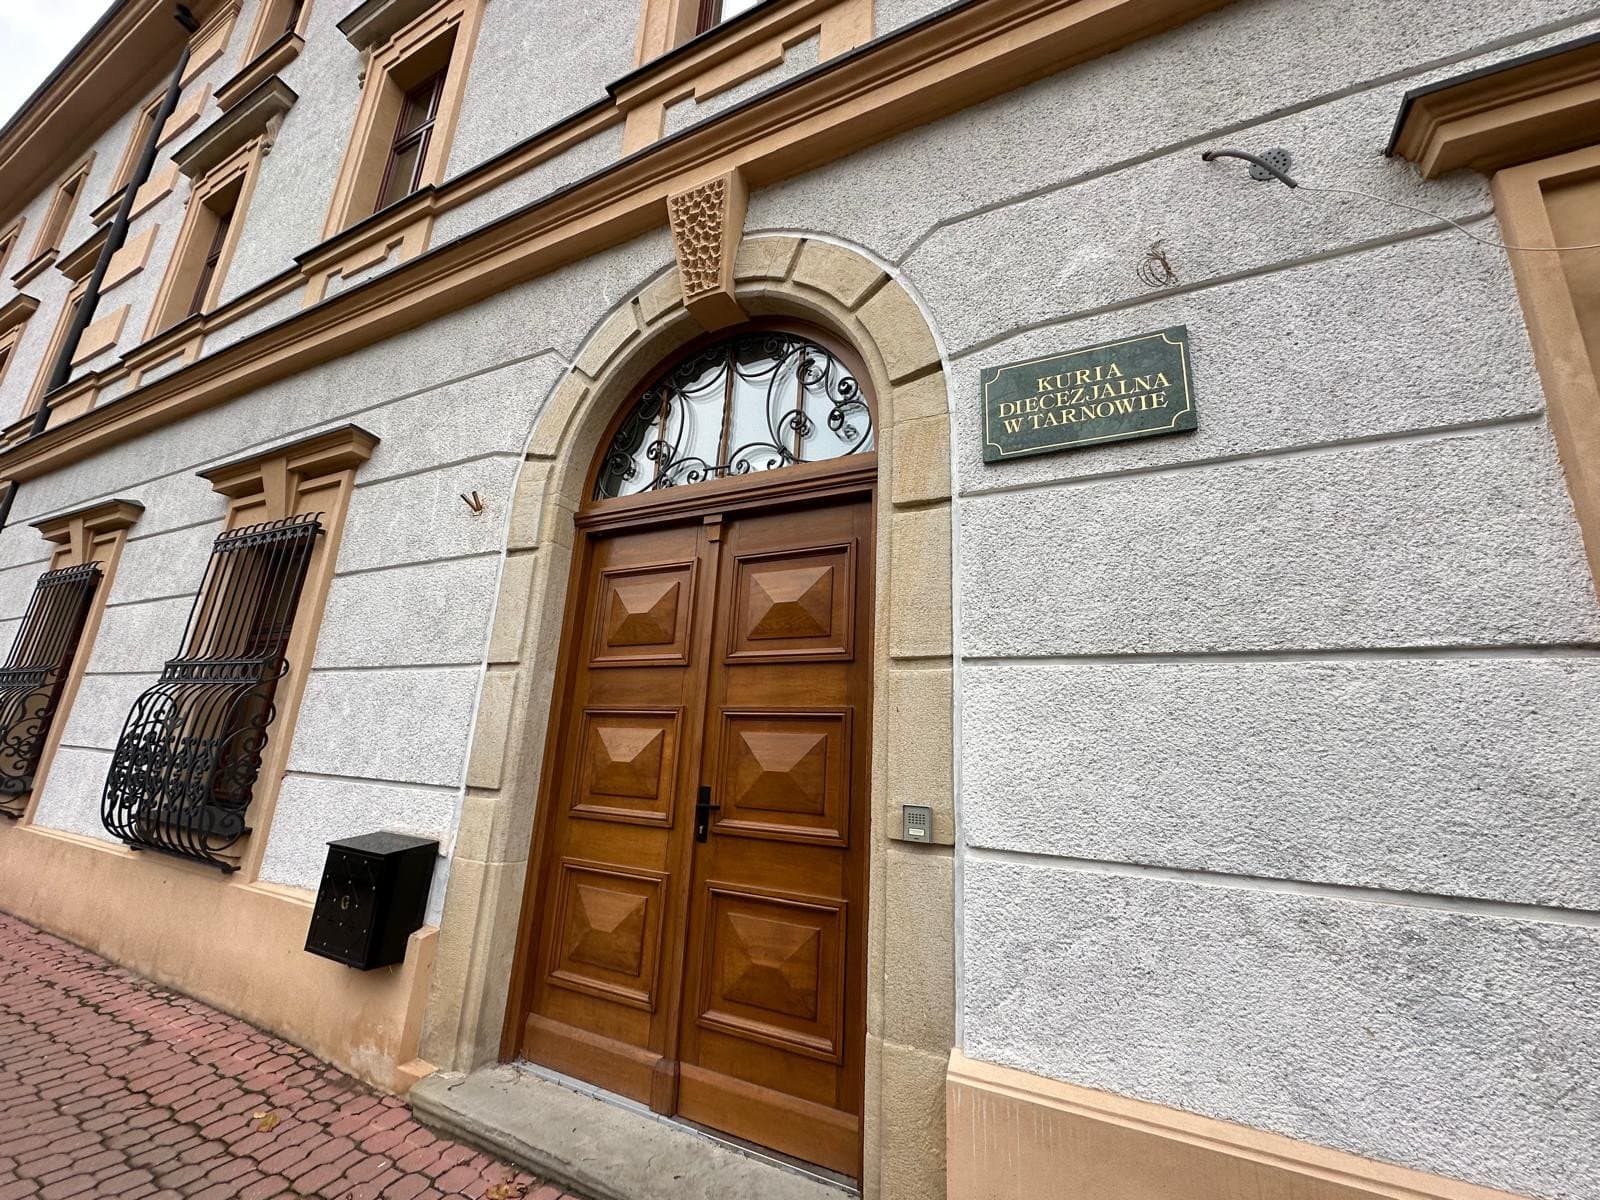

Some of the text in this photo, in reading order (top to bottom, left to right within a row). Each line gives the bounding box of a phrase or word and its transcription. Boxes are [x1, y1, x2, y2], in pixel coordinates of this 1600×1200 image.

[999, 372, 1172, 418] DIECEZJALNA
[1037, 362, 1123, 393] KURIA
[1004, 391, 1169, 434] W TARNOWIE
